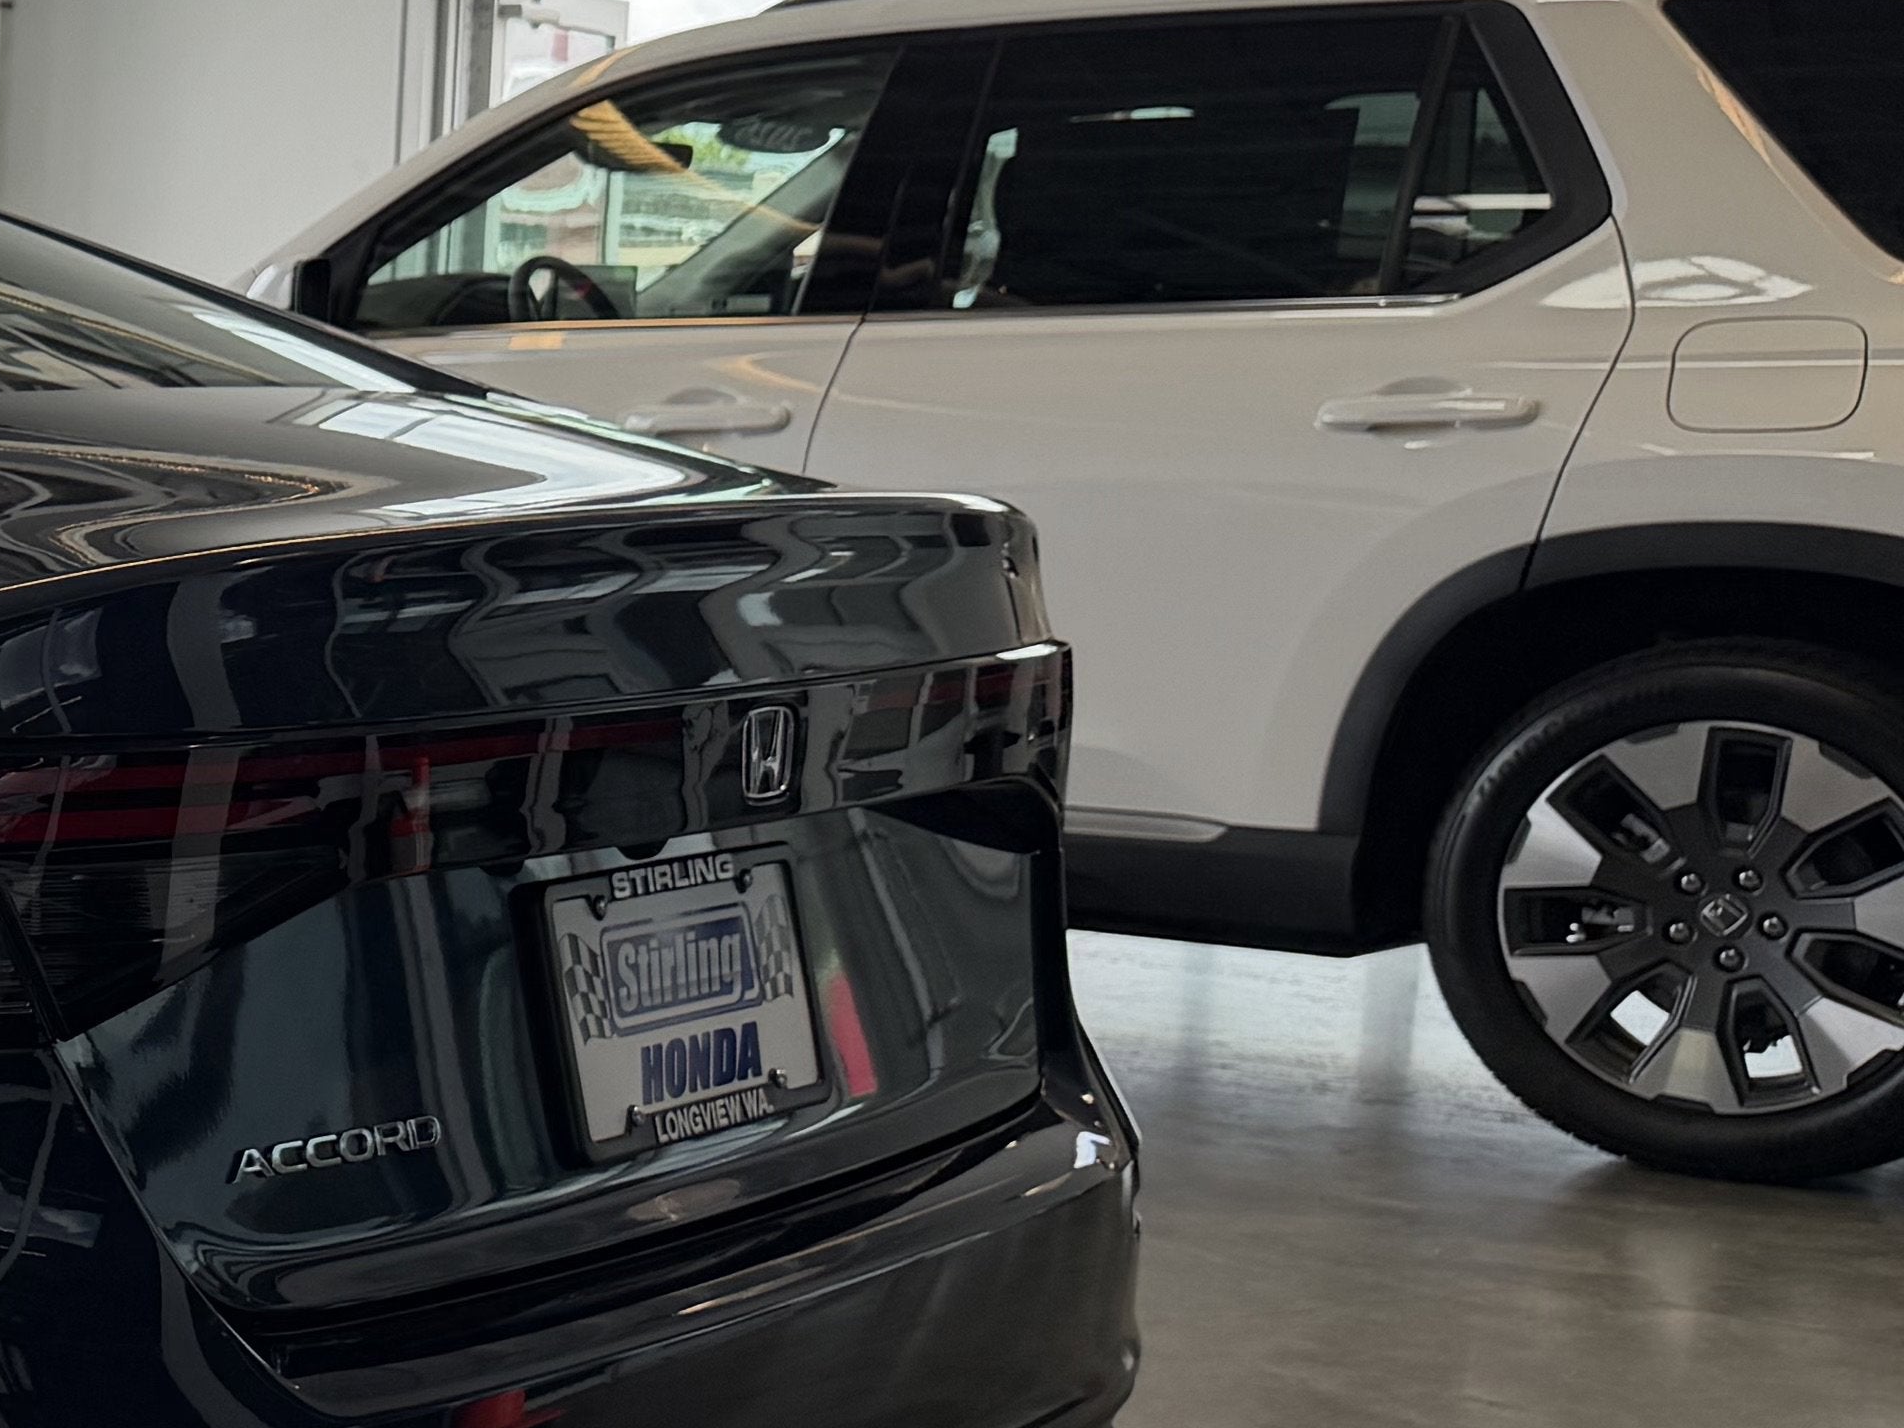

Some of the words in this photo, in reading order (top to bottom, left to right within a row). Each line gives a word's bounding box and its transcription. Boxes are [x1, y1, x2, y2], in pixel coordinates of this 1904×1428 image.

[612, 853, 735, 899] STIRLING
[618, 929, 744, 1012] Stirling
[642, 1021, 762, 1105] HONDA
[228, 1115, 442, 1184] ACCORD
[654, 1090, 742, 1143] LONGVIEW
